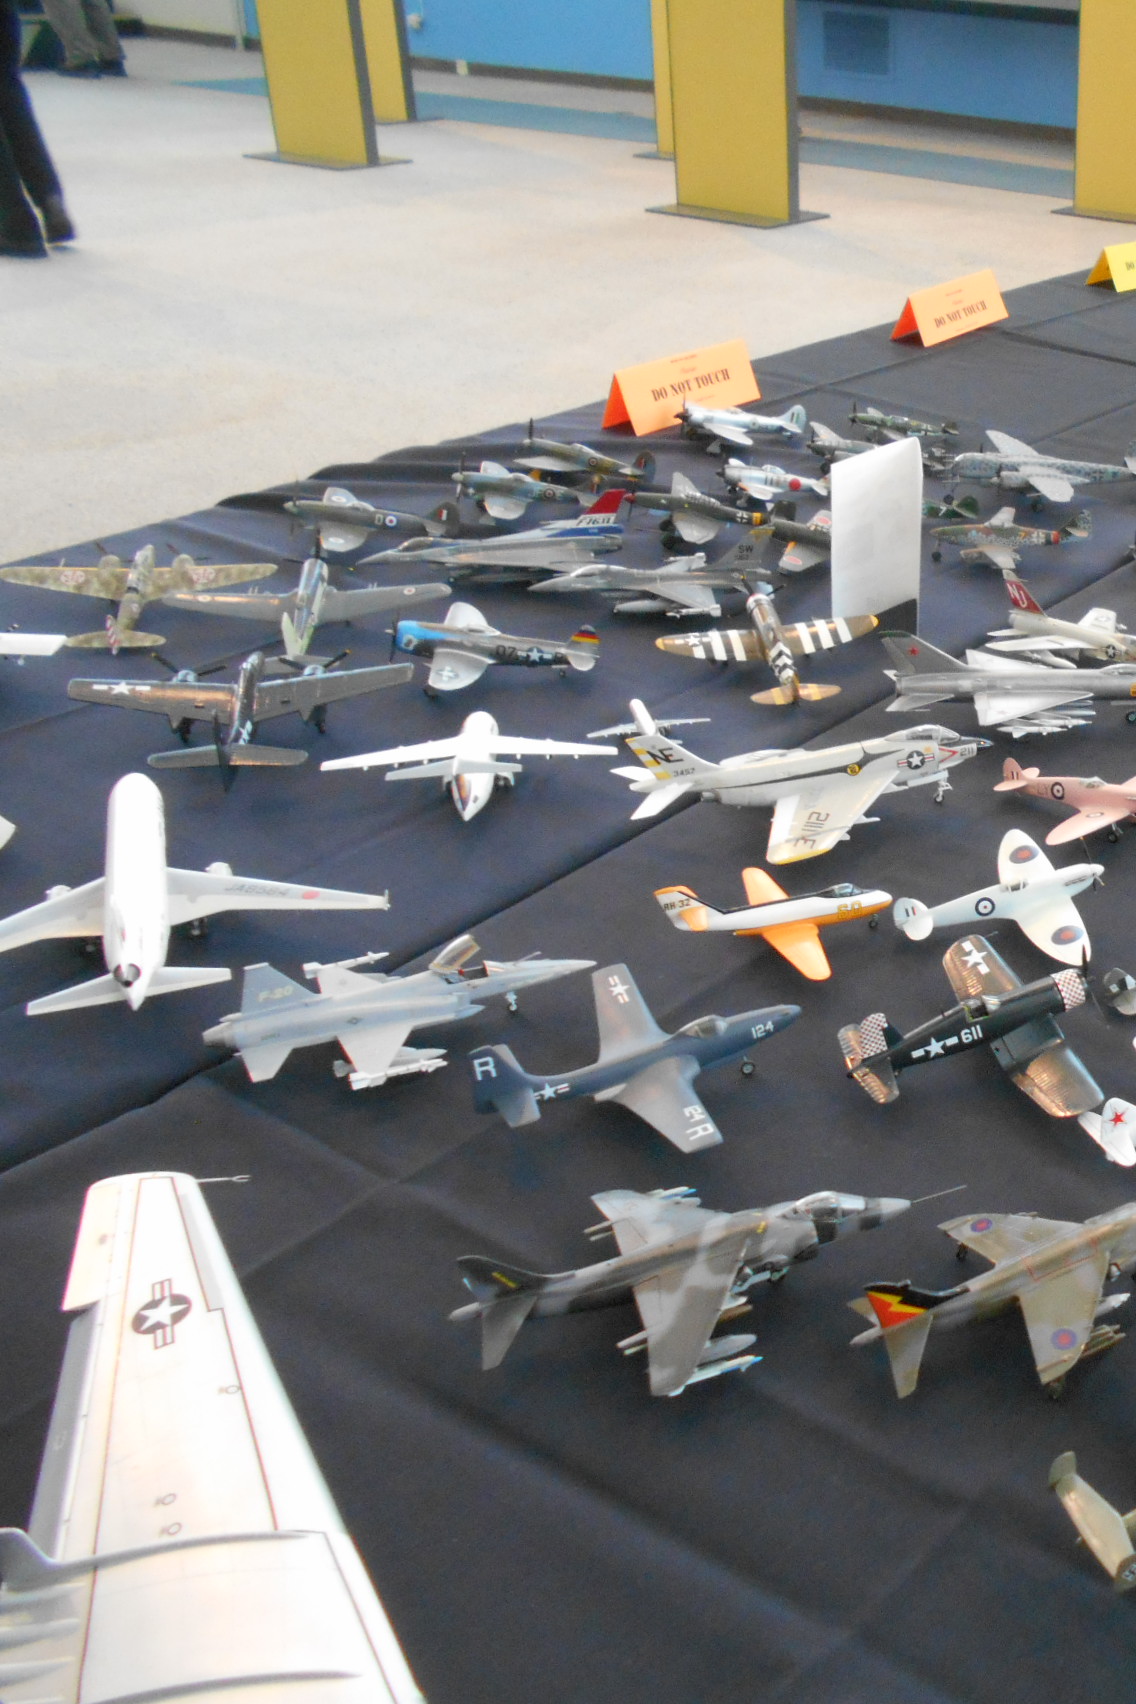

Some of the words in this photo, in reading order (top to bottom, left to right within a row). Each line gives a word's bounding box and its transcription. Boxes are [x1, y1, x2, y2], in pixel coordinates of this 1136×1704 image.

[1125, 259, 1135, 271] DO
[934, 316, 946, 328] DO
[945, 309, 962, 322] NOT
[962, 300, 987, 317] TOUCH
[651, 386, 668, 402] DO
[669, 379, 692, 396] NOT
[693, 367, 731, 389] TOUCH
[645, 747, 684, 766] NE
[751, 1020, 774, 1039] 124
[960, 1024, 983, 1044] 611
[473, 1056, 497, 1081] R
